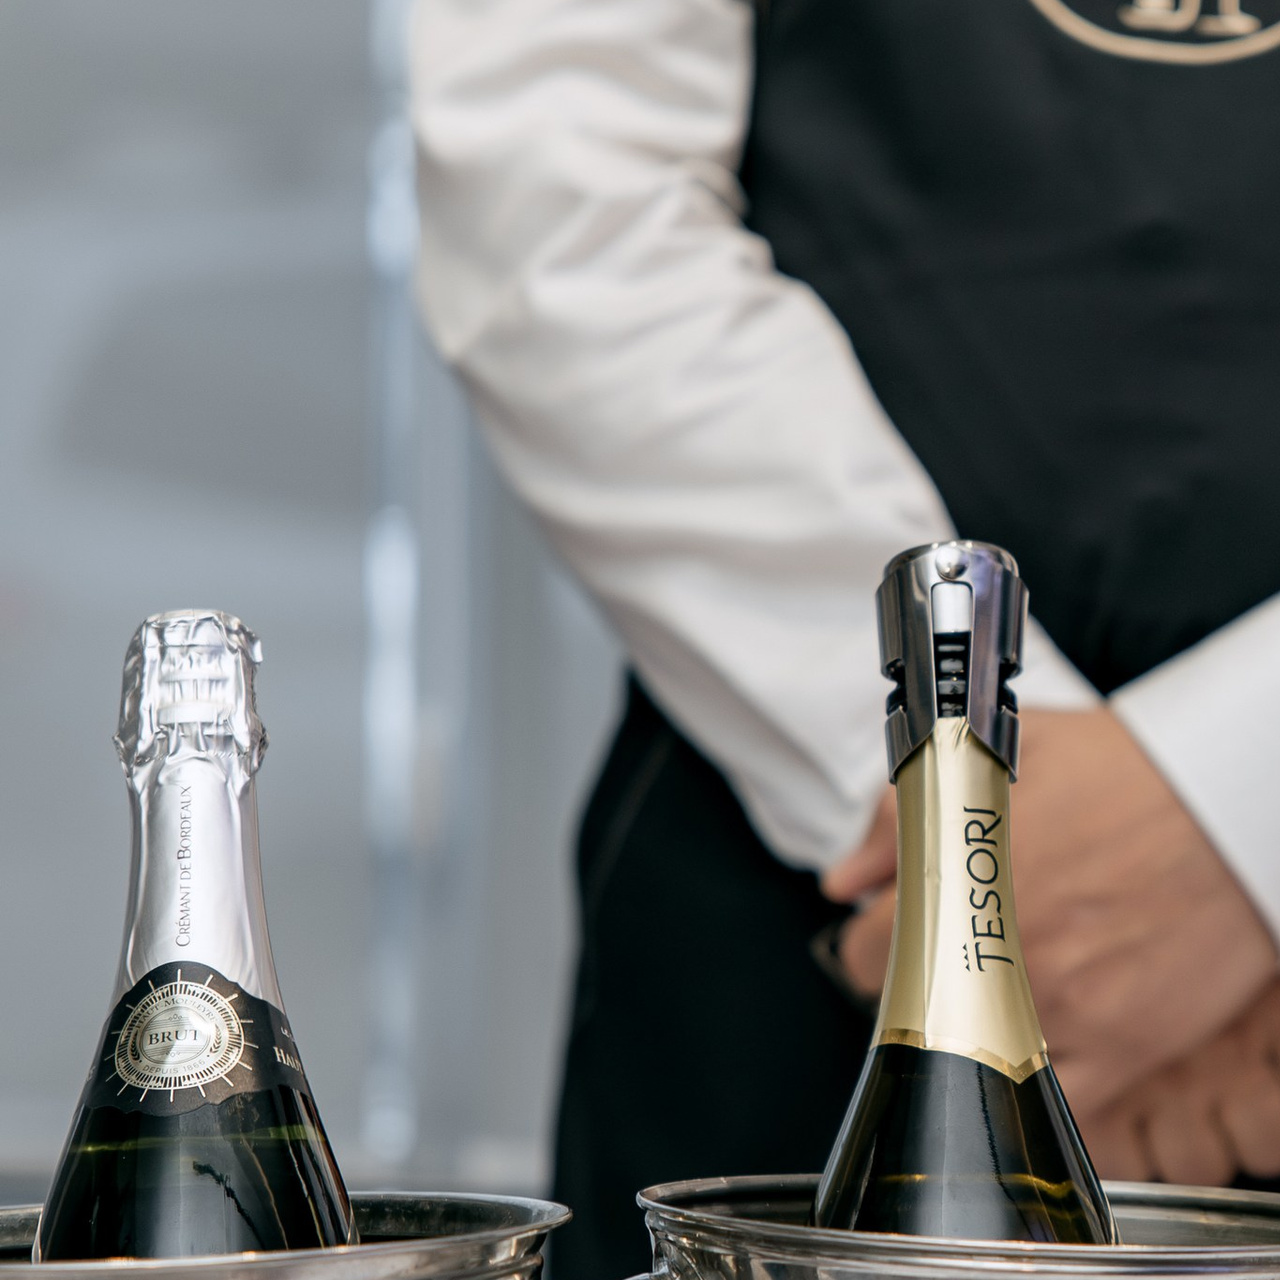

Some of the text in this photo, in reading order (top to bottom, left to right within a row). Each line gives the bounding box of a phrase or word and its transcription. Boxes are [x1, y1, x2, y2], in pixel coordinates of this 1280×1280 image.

[175, 785, 191, 948] CRÉMANT DE BORDEAUX
[963, 806, 1014, 972] TESORI
[142, 1064, 179, 1075] DEPUIS
[148, 1030, 198, 1047] BRUT
